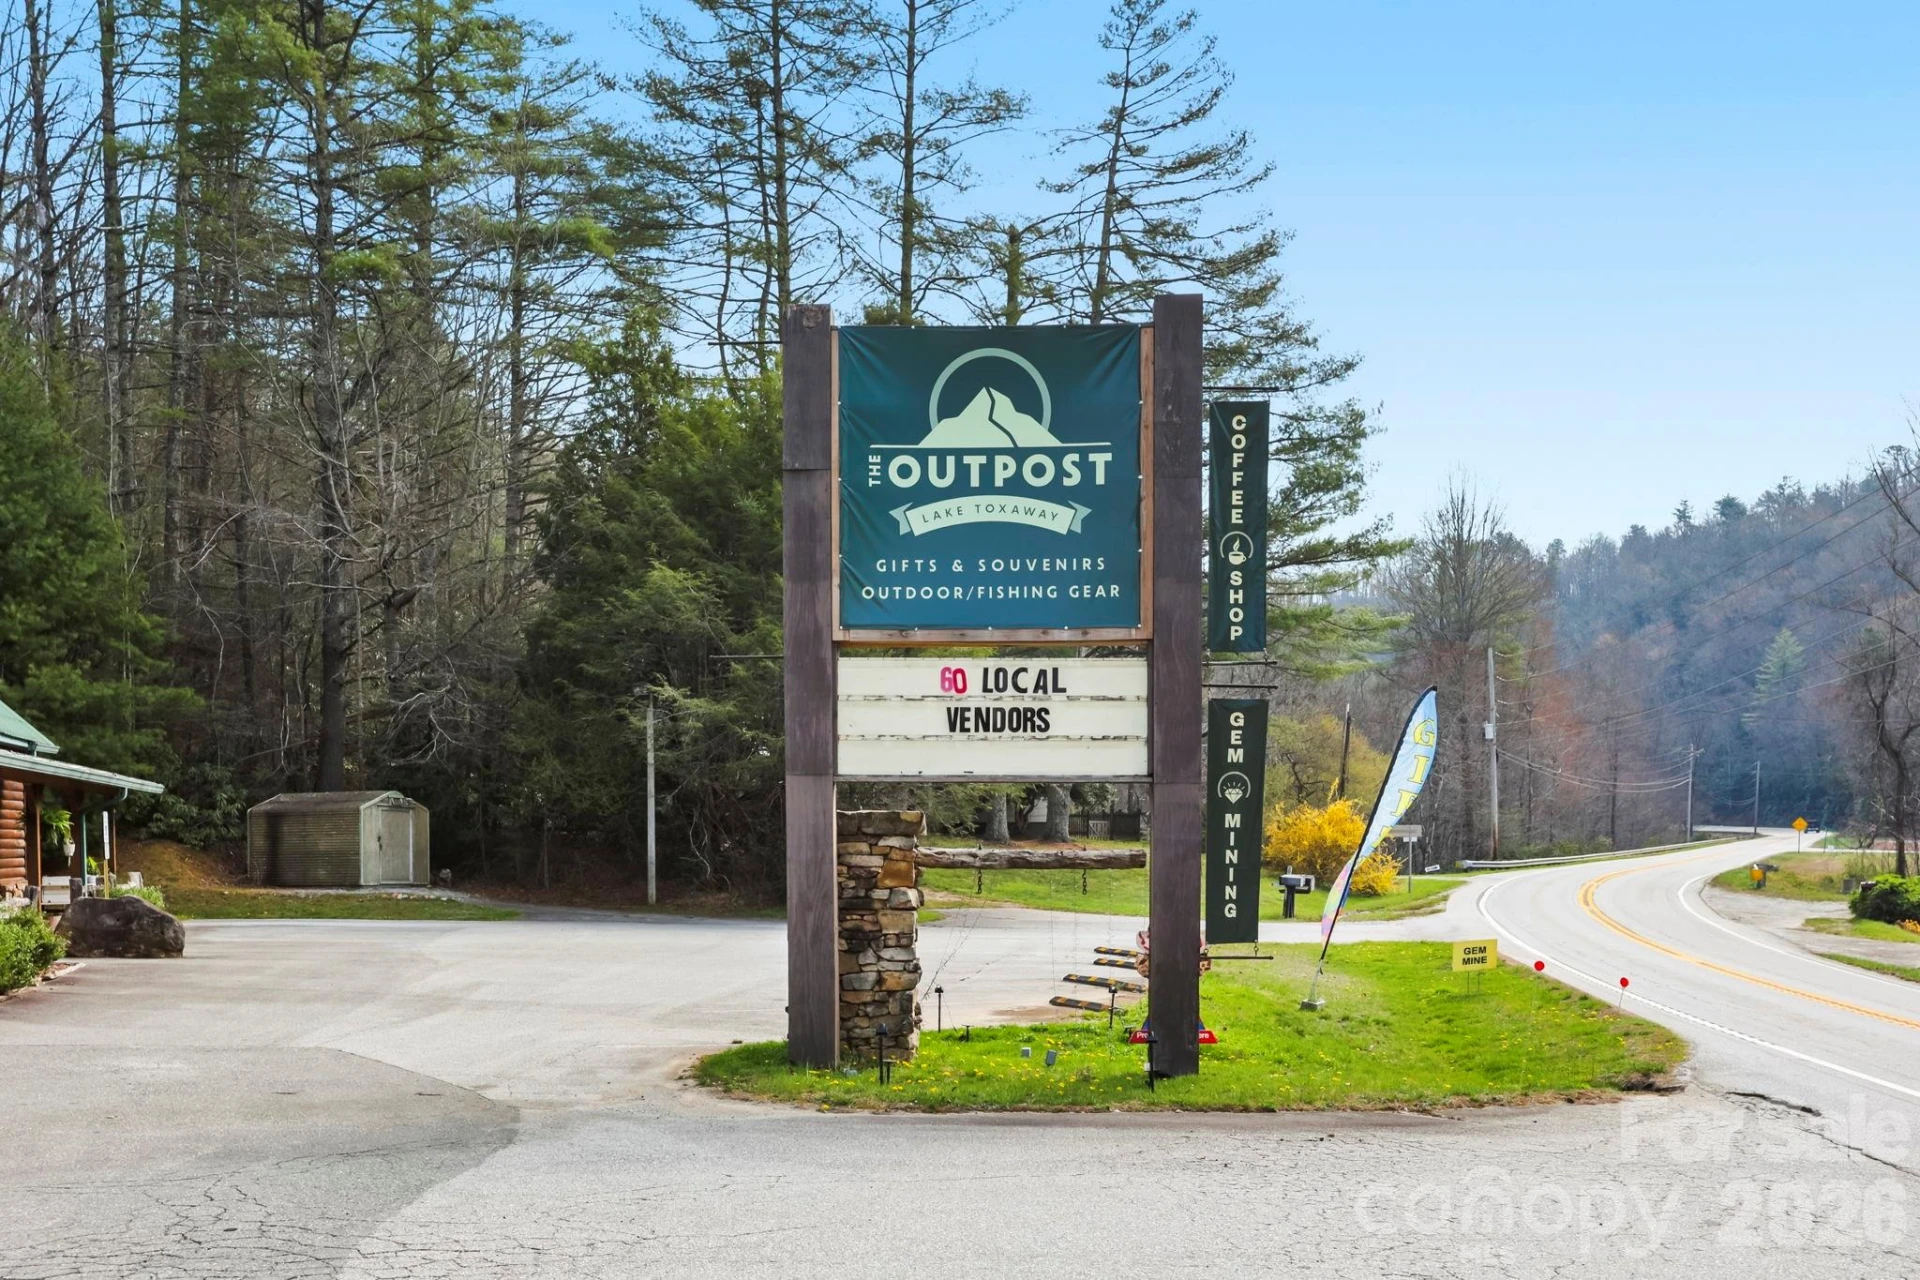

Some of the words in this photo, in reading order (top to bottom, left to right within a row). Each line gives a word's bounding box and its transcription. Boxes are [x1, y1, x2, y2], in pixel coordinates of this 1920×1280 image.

[868, 454, 881, 487] THE
[888, 452, 1113, 488] OUTPOST
[1230, 414, 1247, 524] COFFEE
[921, 506, 963, 523] LAKE
[975, 503, 1059, 521] TOXAWAY
[876, 559, 937, 572] GIFTS
[951, 559, 963, 572] &
[978, 557, 1105, 572] SOUVENIRS
[861, 585, 1058, 600] OUTDOOR/FISHING
[1069, 584, 1120, 598] GEAR
[1229, 570, 1244, 641] SHOP
[940, 666, 968, 694] 60
[982, 667, 1067, 694] LOCAL
[946, 706, 1050, 733] VENDORS
[1227, 711, 1244, 763] GEM
[1224, 813, 1241, 918] MINING
[1462, 956, 1488, 966] MINE
[1463, 946, 1487, 955] GEM
